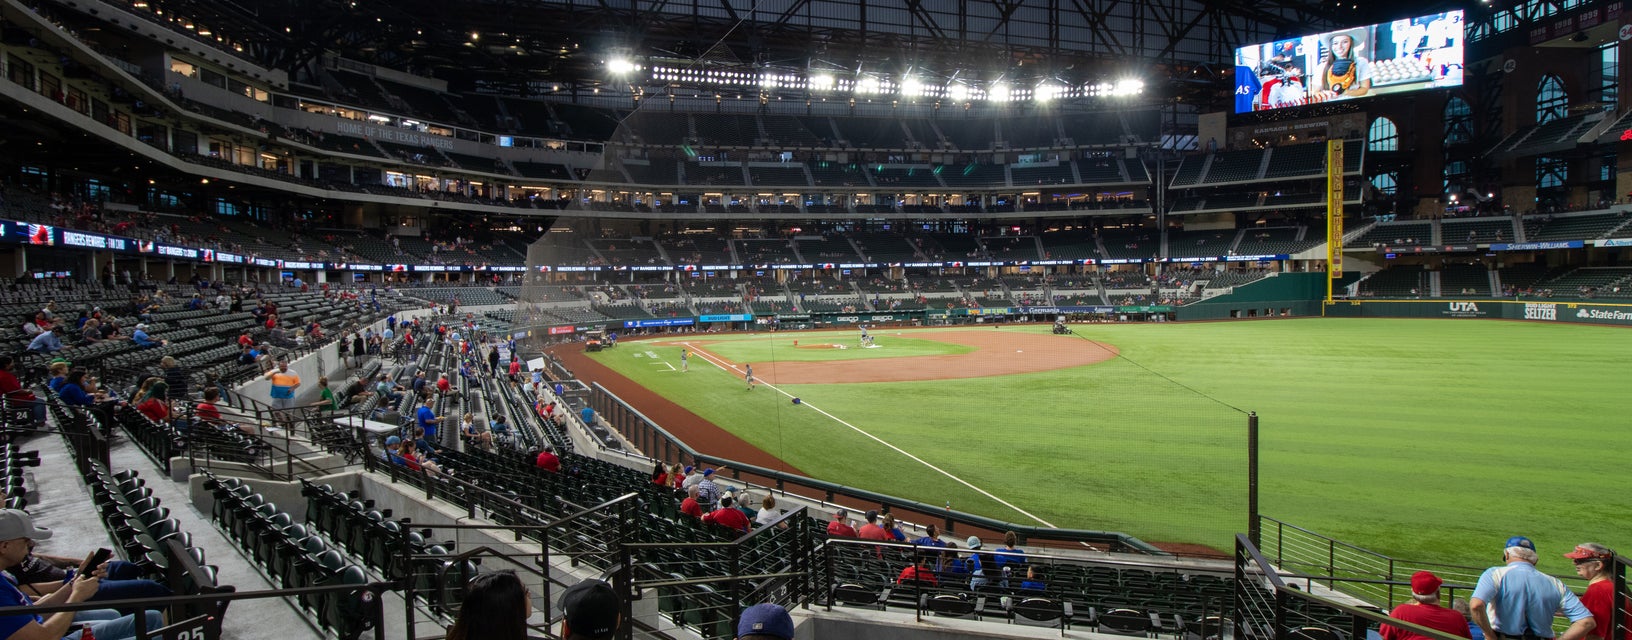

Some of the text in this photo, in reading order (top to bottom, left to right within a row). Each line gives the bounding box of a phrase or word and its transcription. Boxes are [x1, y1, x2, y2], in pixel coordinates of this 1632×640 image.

[1608, 2, 1623, 12] 201
[1580, 9, 1598, 21] 1999
[1235, 85, 1250, 95] AS
[1294, 121, 1329, 130] BREWING
[337, 122, 454, 150] HOME OF THE TEXAS RANGERS
[63, 231, 86, 247] RANGERS
[86, 234, 106, 249] REWARDS
[1506, 242, 1569, 250] SHERWIN-WILLIAMS
[166, 246, 183, 257] RANGERS
[1449, 302, 1479, 312] UTA
[1524, 308, 1557, 321] SELTZER
[16, 411, 28, 420] 24
